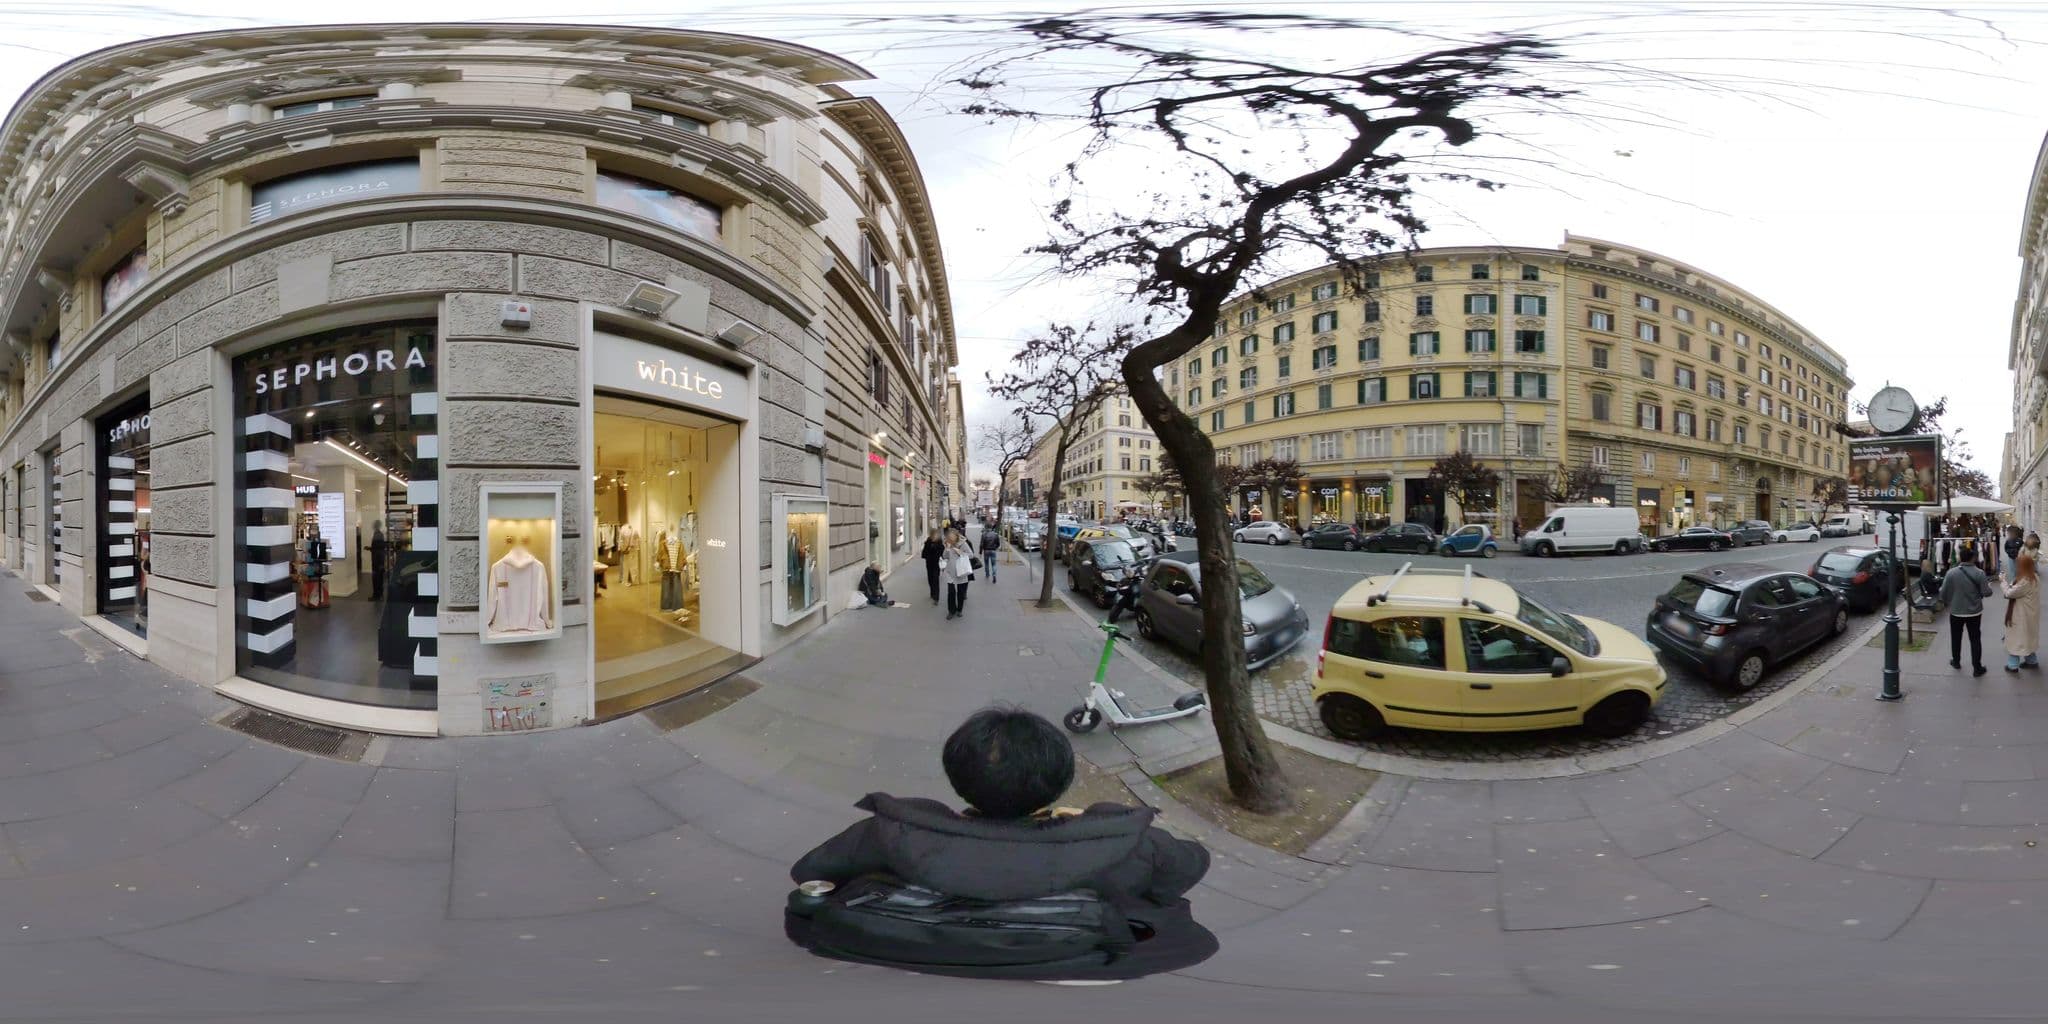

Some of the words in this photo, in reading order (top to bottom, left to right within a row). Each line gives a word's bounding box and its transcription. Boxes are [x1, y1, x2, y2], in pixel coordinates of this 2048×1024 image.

[280, 180, 390, 209] SEPHORA
[255, 346, 426, 394] SEPHORA
[637, 359, 722, 399] white
[296, 485, 316, 494] HUB
[1860, 488, 1912, 497] SEPHORA
